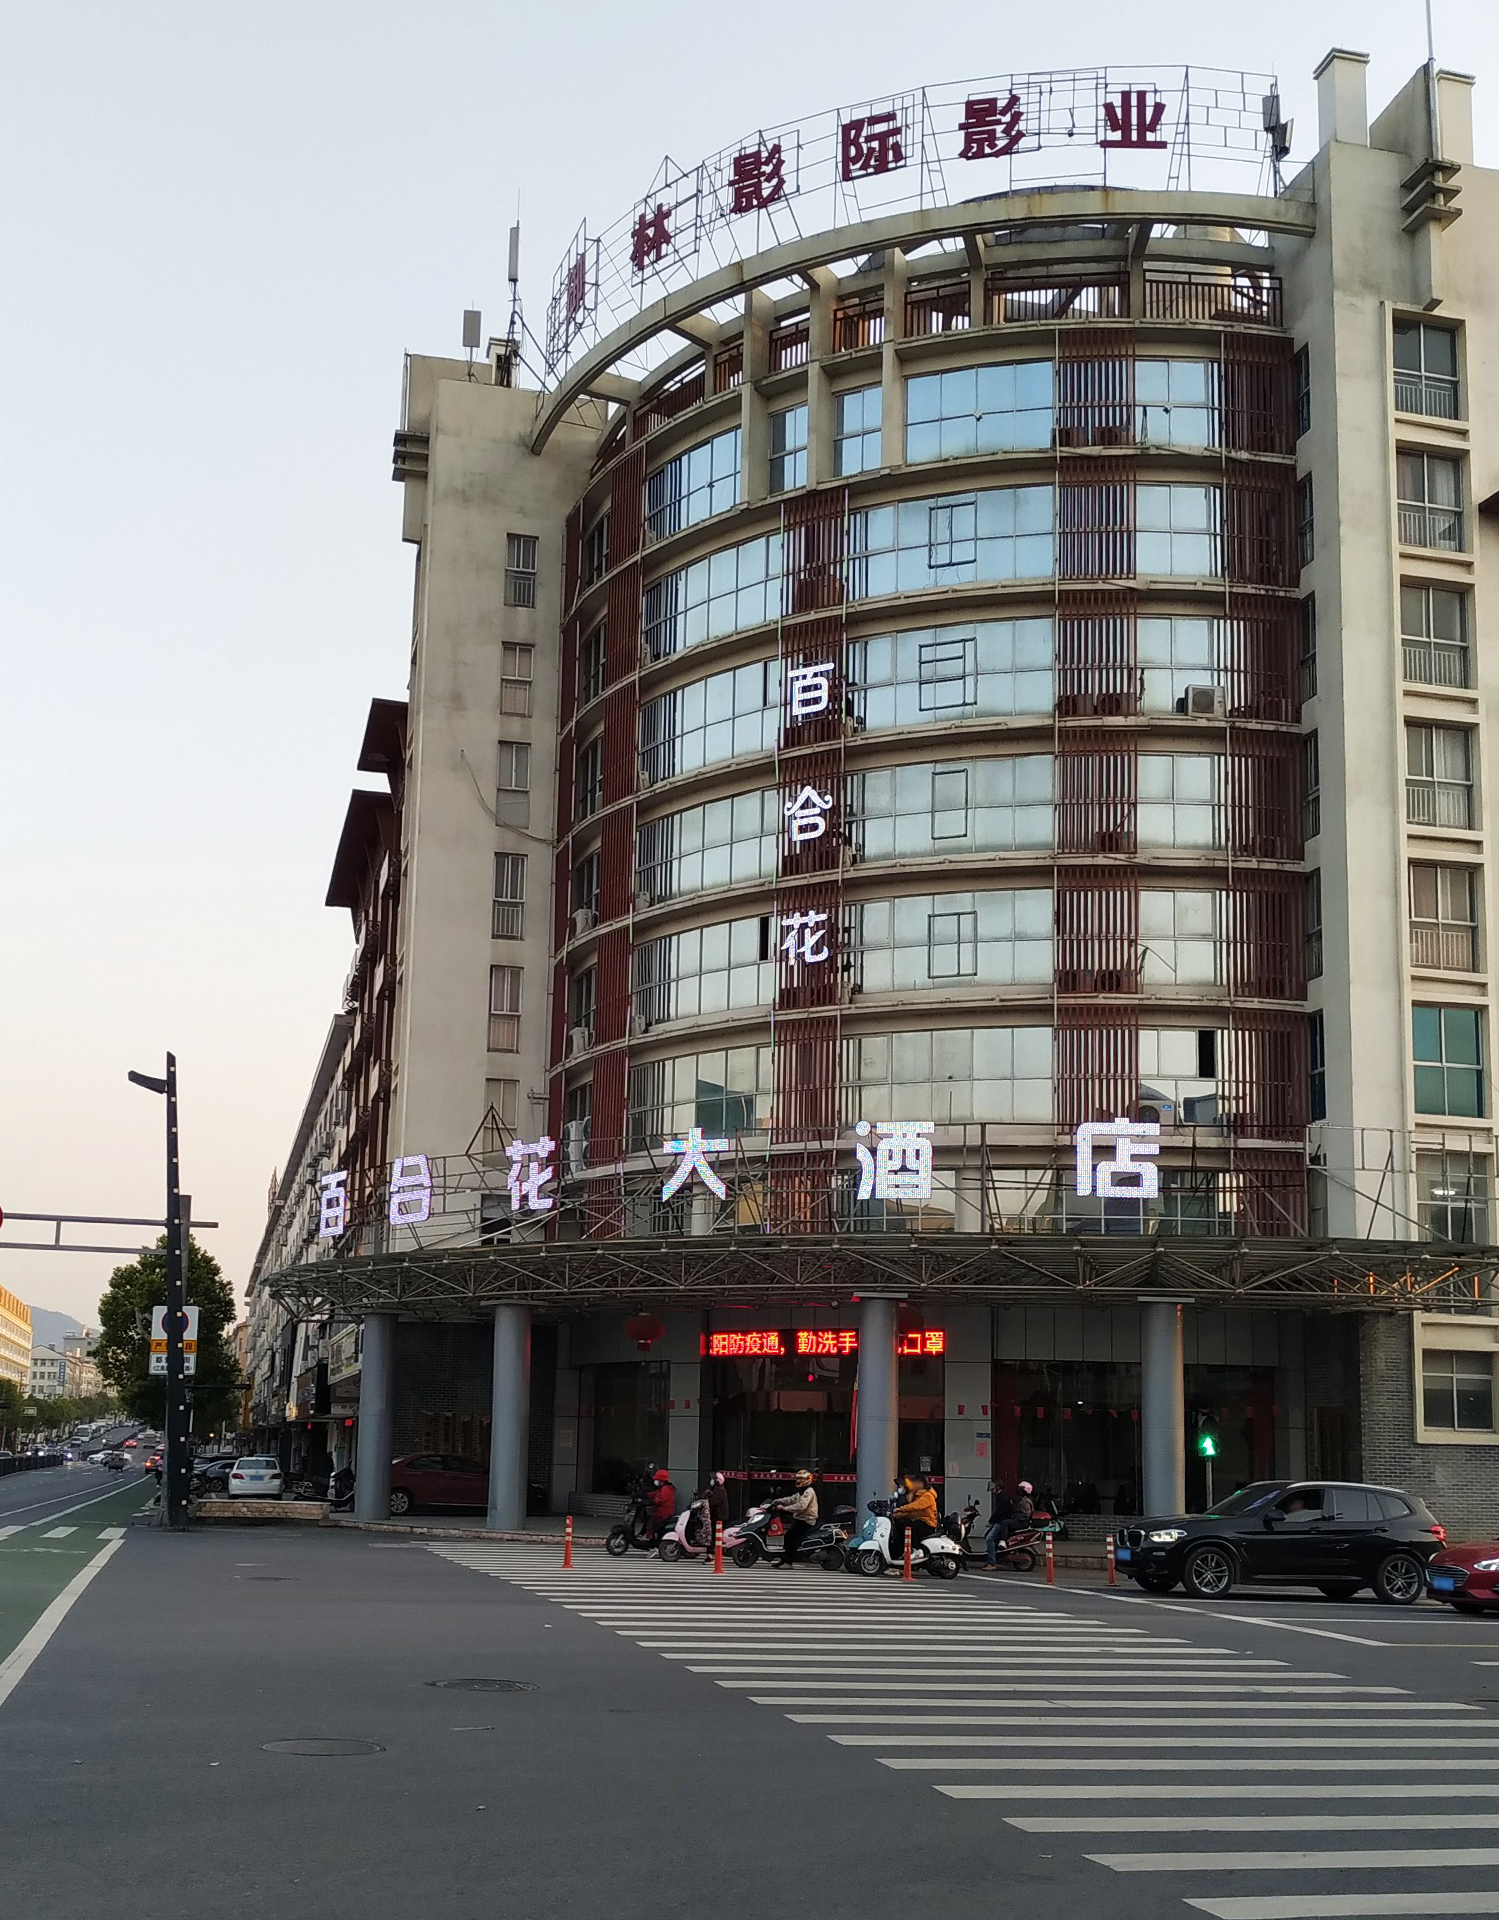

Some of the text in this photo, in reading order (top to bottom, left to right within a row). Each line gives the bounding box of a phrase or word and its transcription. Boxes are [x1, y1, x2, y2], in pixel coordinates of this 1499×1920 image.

[781, 662, 835, 966] 百合花
[318, 1116, 1161, 1238] 百合花大酒店
[897, 1331, 944, 1355] 口罩
